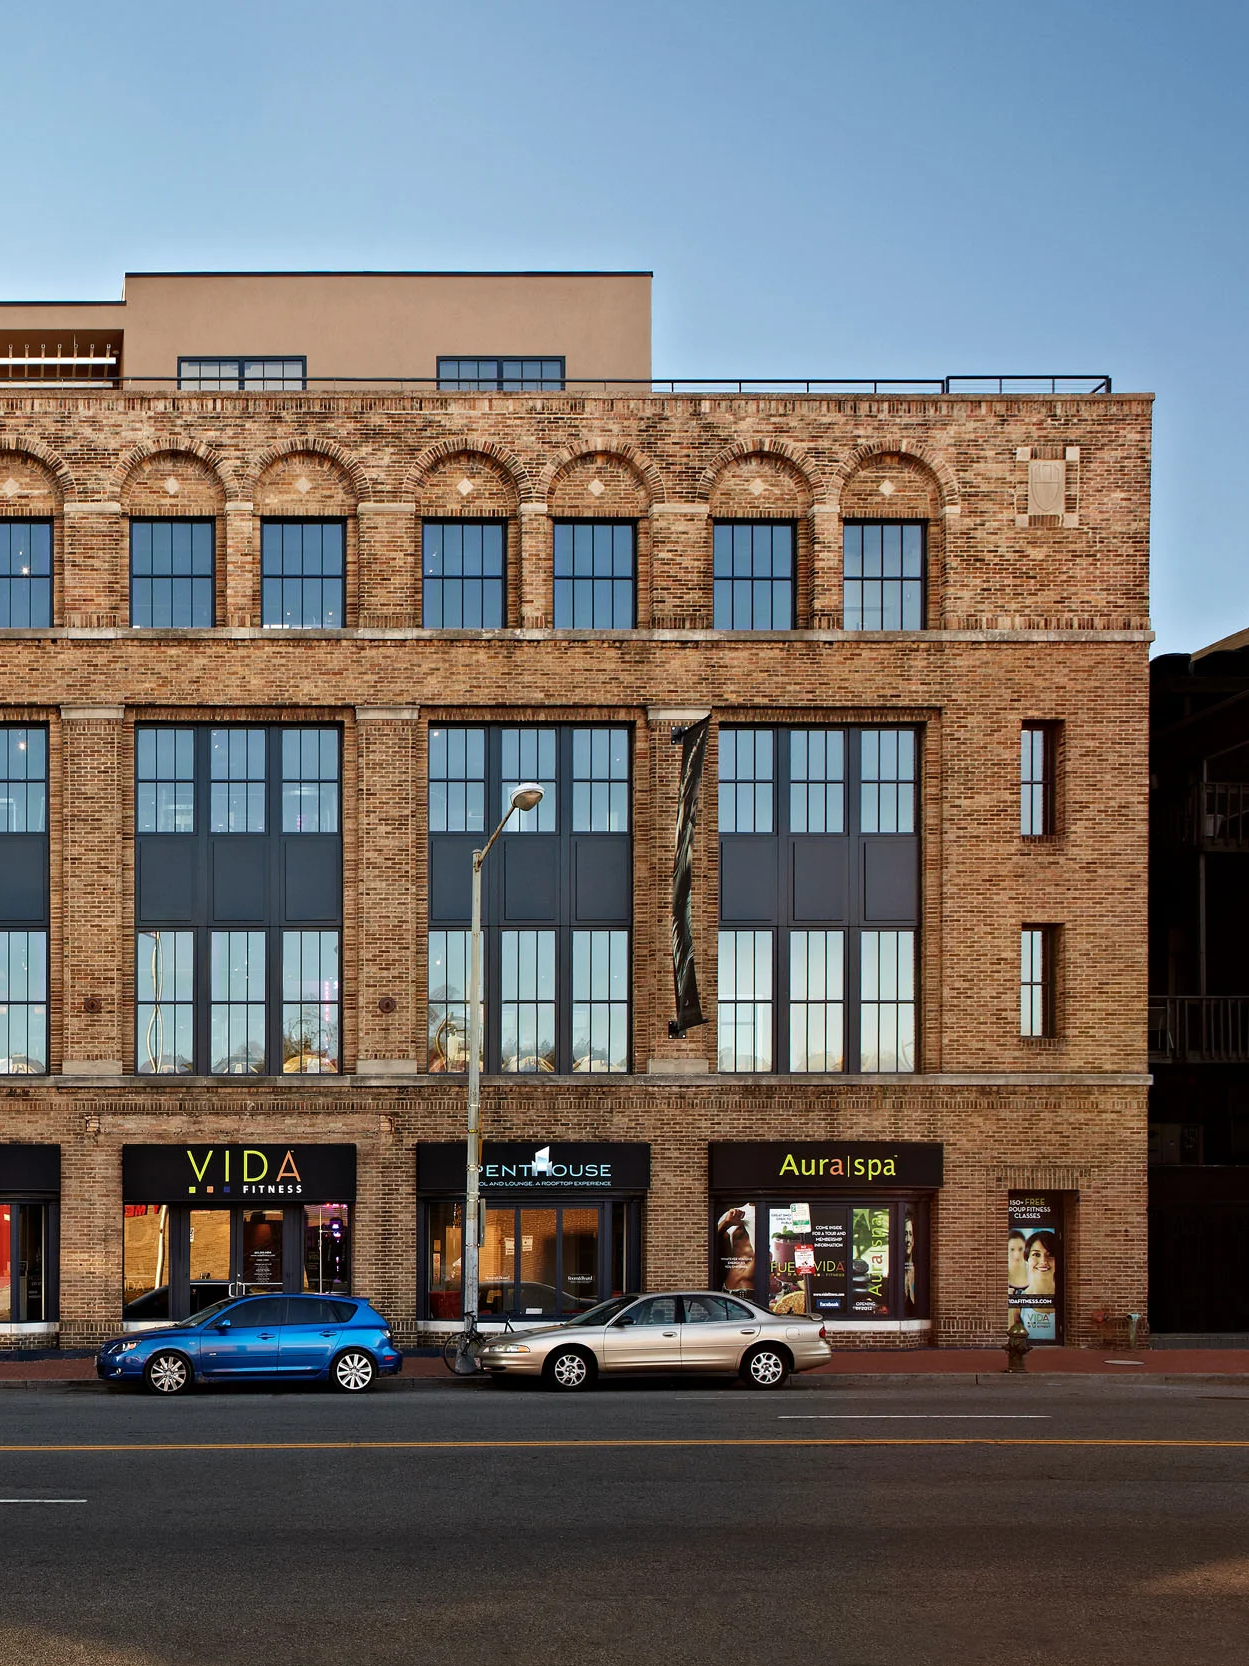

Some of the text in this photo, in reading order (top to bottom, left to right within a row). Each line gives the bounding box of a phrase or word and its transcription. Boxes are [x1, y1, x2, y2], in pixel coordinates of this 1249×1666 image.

[186, 1149, 302, 1182] VIDA
[242, 1185, 303, 1194] FITNESS
[1024, 1198, 1045, 1206] FREE
[814, 1260, 845, 1272] VIDA
